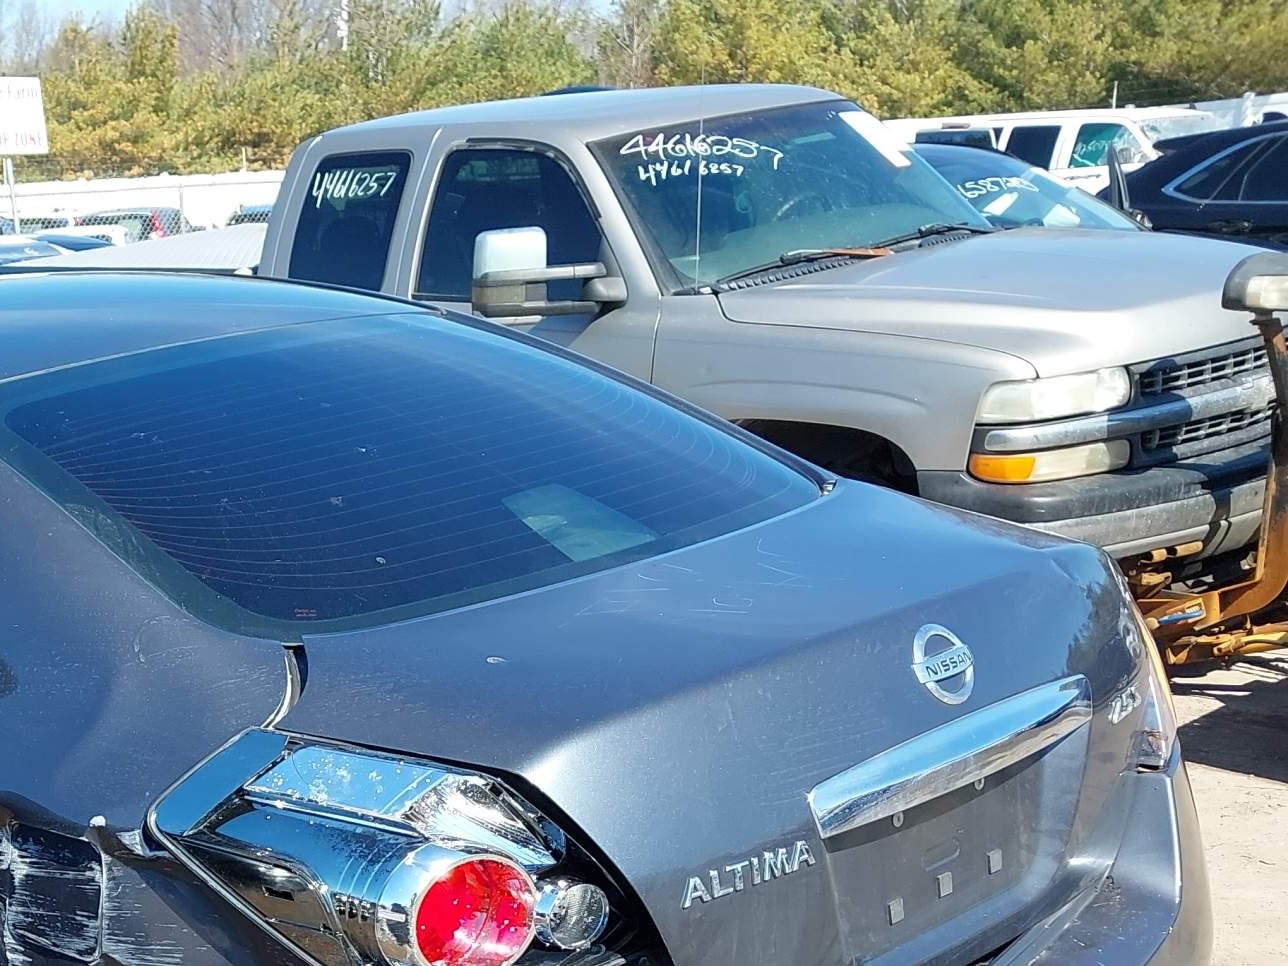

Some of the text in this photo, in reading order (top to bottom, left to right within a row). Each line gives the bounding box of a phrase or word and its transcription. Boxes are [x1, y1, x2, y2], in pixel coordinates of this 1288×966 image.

[312, 169, 397, 209] 44616257
[637, 159, 745, 187] 44616257
[924, 651, 972, 678] NISSAN
[680, 840, 817, 909] ALTIMA
